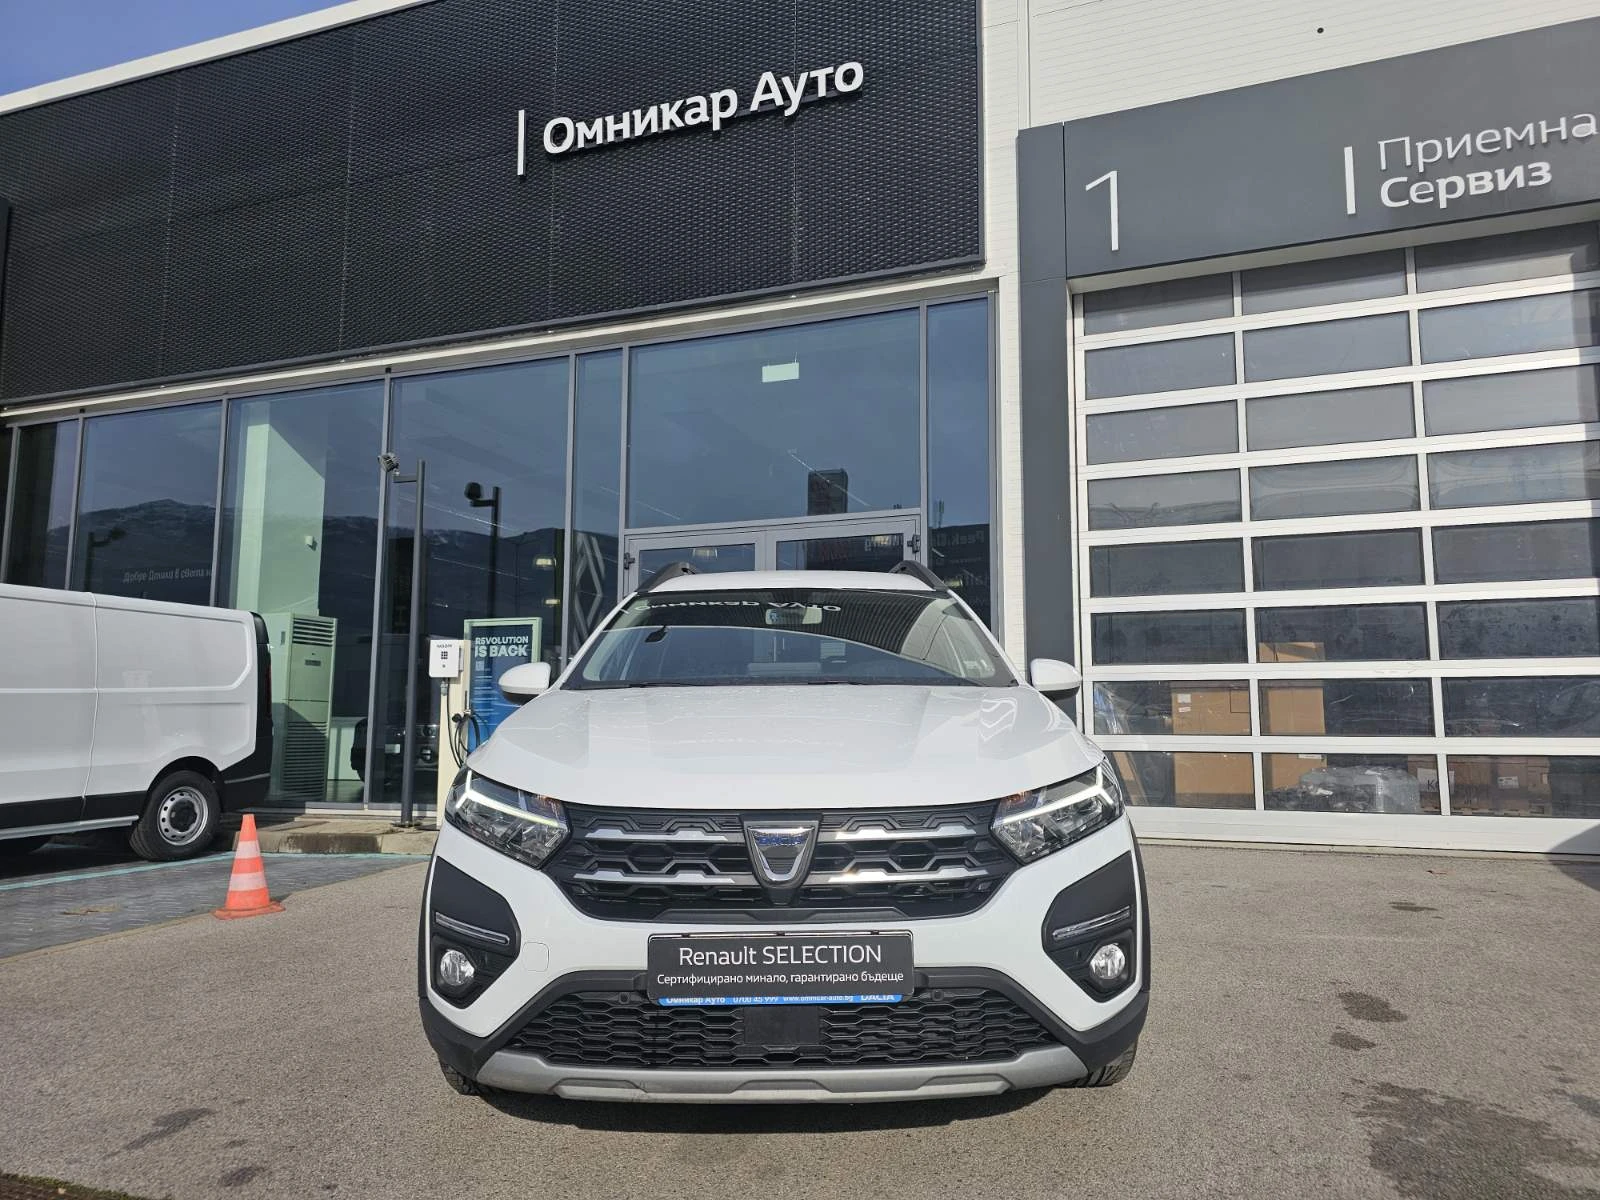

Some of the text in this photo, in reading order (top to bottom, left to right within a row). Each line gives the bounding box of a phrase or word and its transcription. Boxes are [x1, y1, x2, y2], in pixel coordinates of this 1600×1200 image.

[543, 61, 864, 154] Омникар Ауто
[1377, 113, 1599, 173] Приемна
[1379, 161, 1552, 209] Сервиз
[1085, 170, 1119, 252] 1
[474, 645, 529, 658] IS BACK
[657, 971, 904, 987] Сертифицирано минало, гарантирано бъдеще
[679, 945, 881, 966] Renault SELECTION
